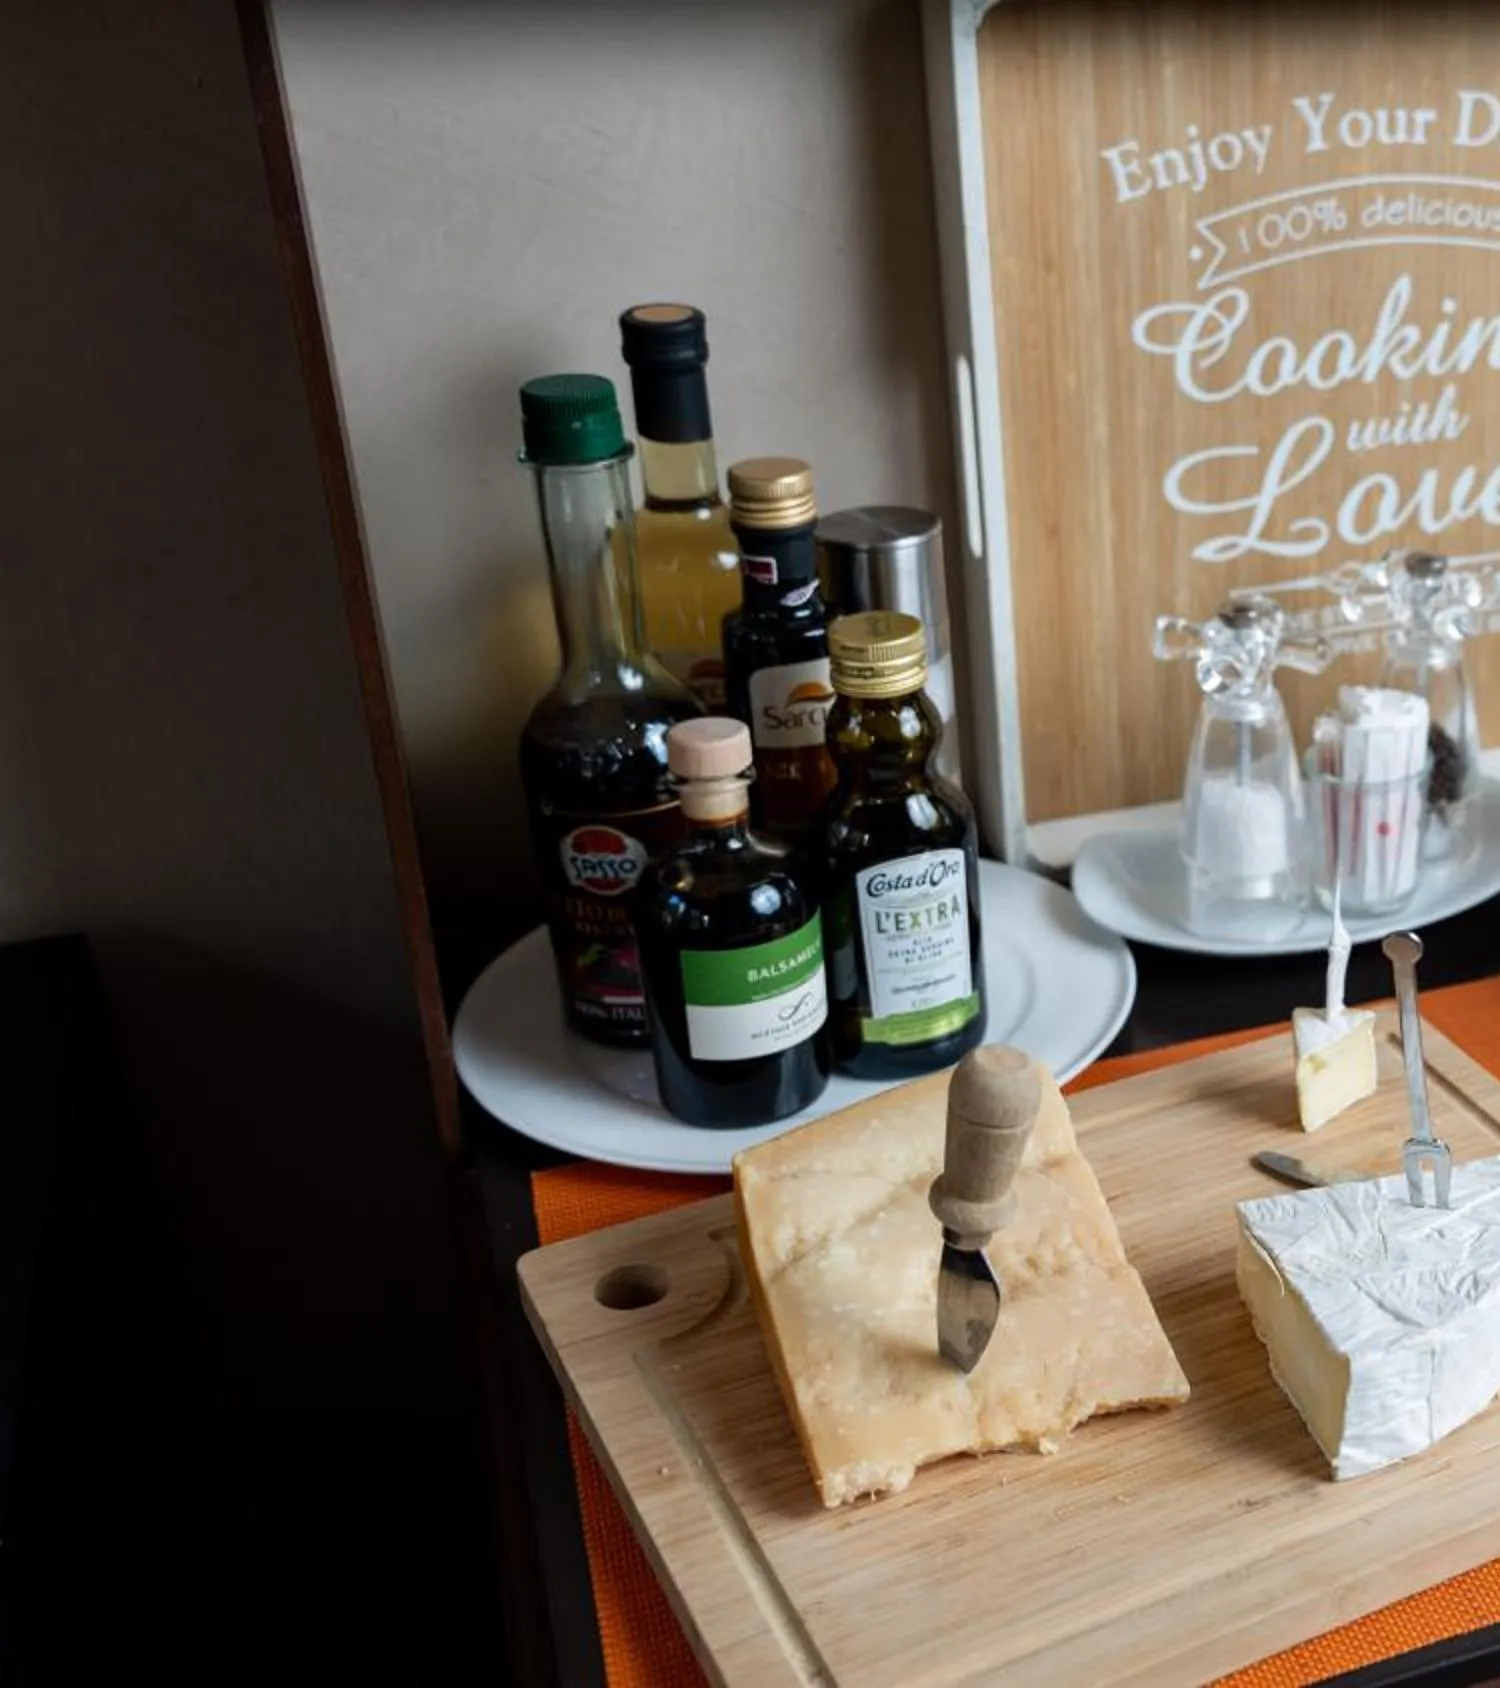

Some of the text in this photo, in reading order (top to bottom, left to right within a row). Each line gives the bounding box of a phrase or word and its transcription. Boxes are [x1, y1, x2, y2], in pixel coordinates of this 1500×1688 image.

[1100, 125, 1274, 202] Enjoy
[1294, 92, 1437, 154] Your
[1238, 199, 1347, 253] 100%
[1346, 384, 1470, 452] with
[569, 855, 637, 879] SASSO
[866, 860, 960, 898] Costa d'Oro
[875, 894, 961, 934] L'EXTRA
[611, 1006, 646, 1022] ITAL
